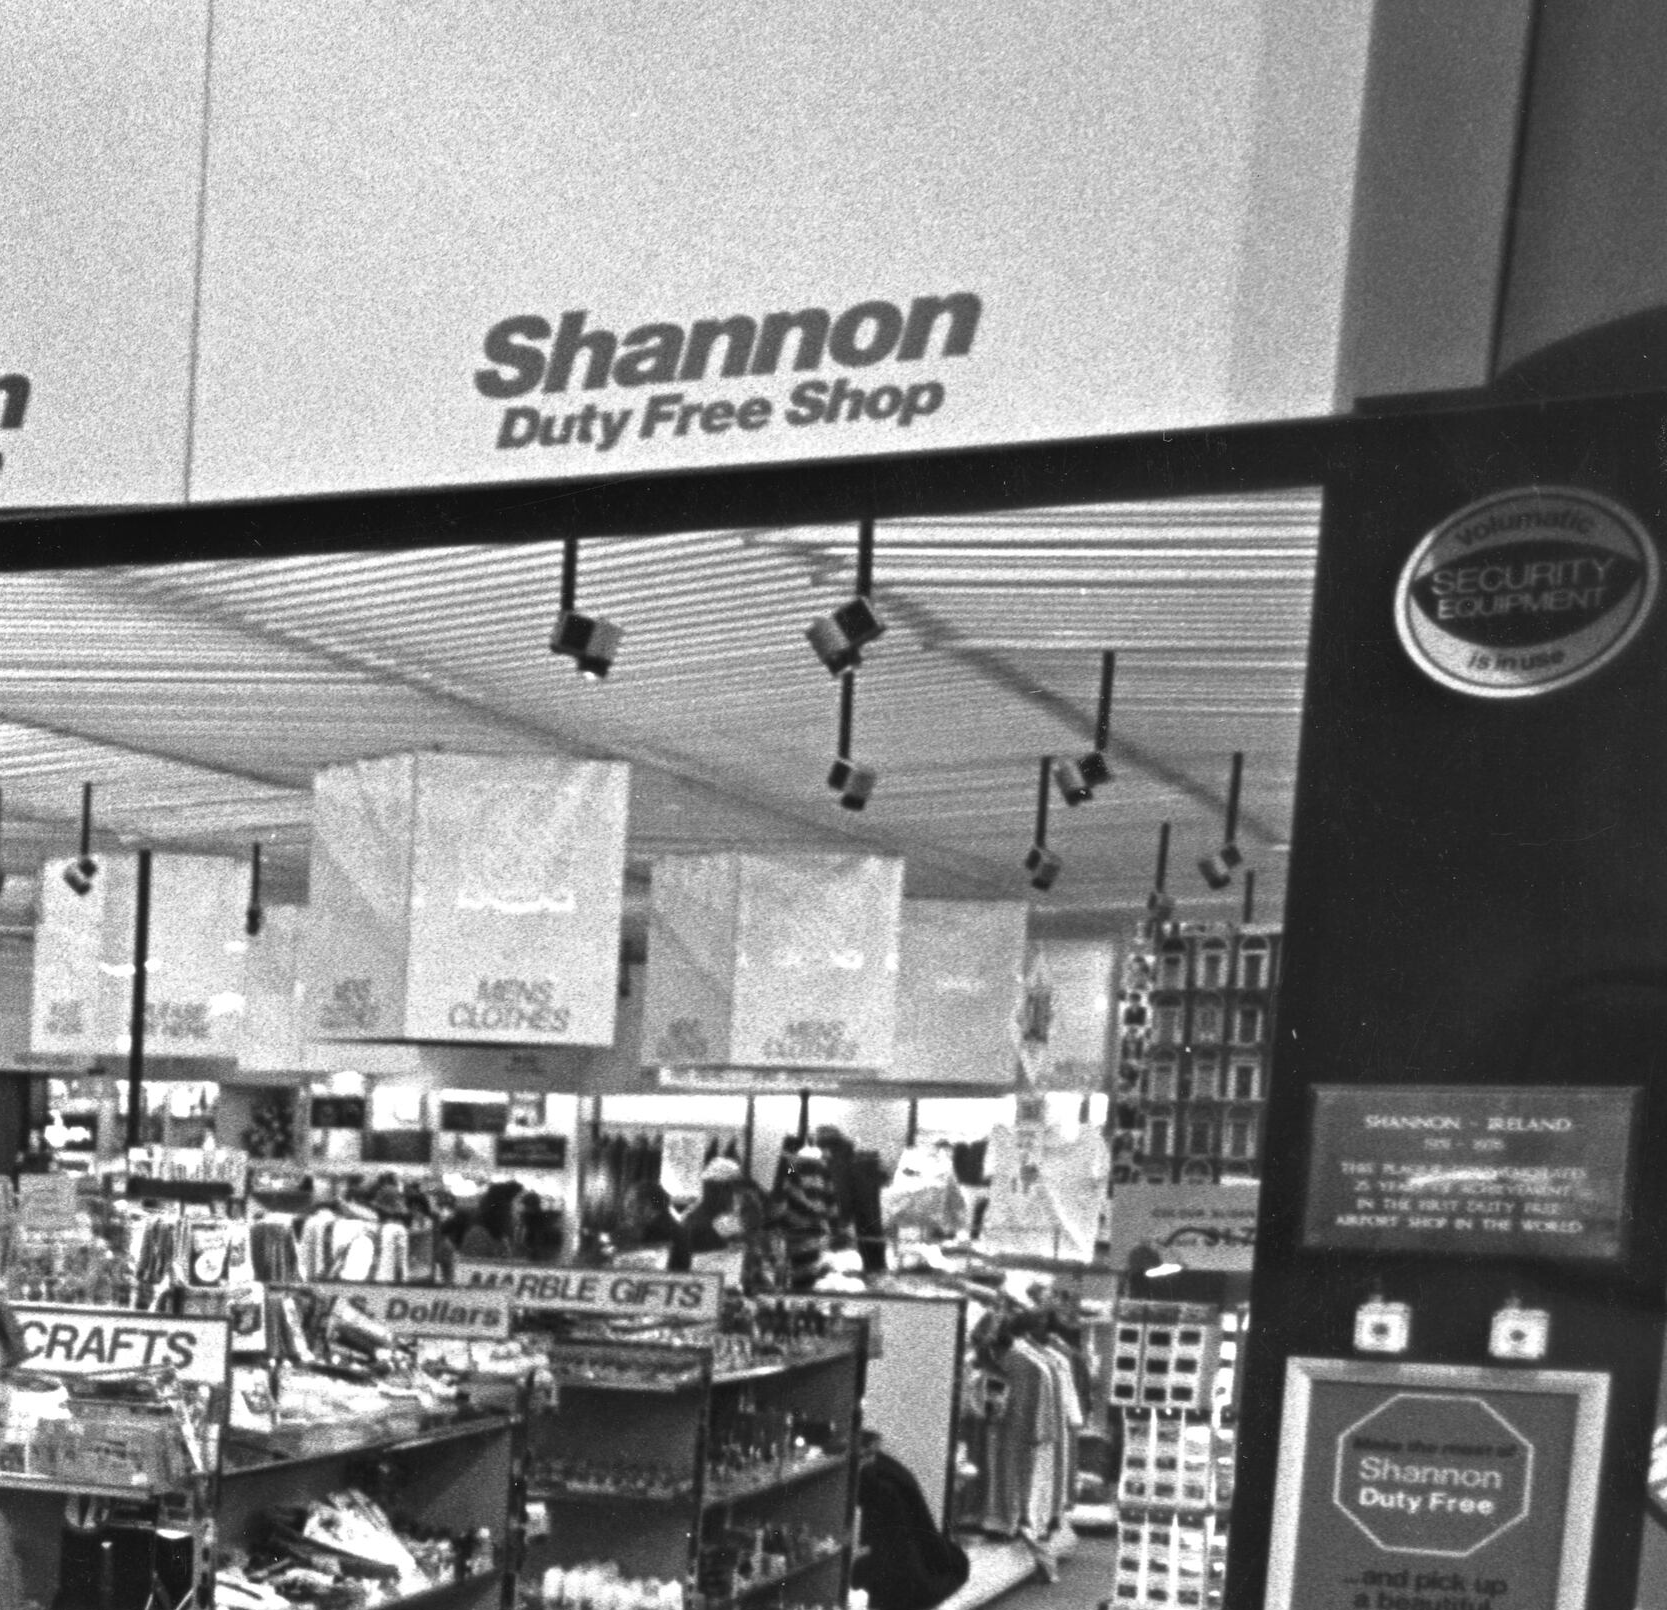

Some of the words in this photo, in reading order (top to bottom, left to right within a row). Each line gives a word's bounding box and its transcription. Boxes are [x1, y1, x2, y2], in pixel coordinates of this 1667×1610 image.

[474, 292, 982, 399] Shannon
[496, 403, 632, 452] Duty
[639, 393, 773, 440] Free
[785, 378, 946, 428] Shop
[1456, 510, 1595, 546] Volumatic
[1431, 557, 1614, 595] SECURITY
[1438, 587, 1606, 620] EQUIPMENT
[1468, 655, 1489, 670] is
[1494, 654, 1517, 671] in
[1520, 650, 1565, 670] use
[476, 979, 554, 1004] MENS
[447, 1002, 570, 1032] CLOTHES
[1366, 1114, 1461, 1130] SHANNON
[1487, 1117, 1572, 1132] IRELAND
[1336, 1215, 1399, 1227] AIRPORT
[1408, 1216, 1448, 1228] SHOP
[1454, 1217, 1473, 1229] IN
[1483, 1218, 1511, 1231] THE
[1521, 1220, 1583, 1233] WORLD
[469, 1269, 601, 1300] MARBLE
[610, 1276, 705, 1308] GIFTS
[385, 1298, 500, 1327] Dollars
[21, 1320, 197, 1370] CRAFTS
[1359, 1456, 1503, 1490] Shannon
[1359, 1487, 1422, 1514] Duty
[1428, 1492, 1494, 1516] Free
[1414, 1572, 1466, 1592] pick
[1474, 1578, 1508, 1598] up
[1353, 1593, 1369, 1609] a
